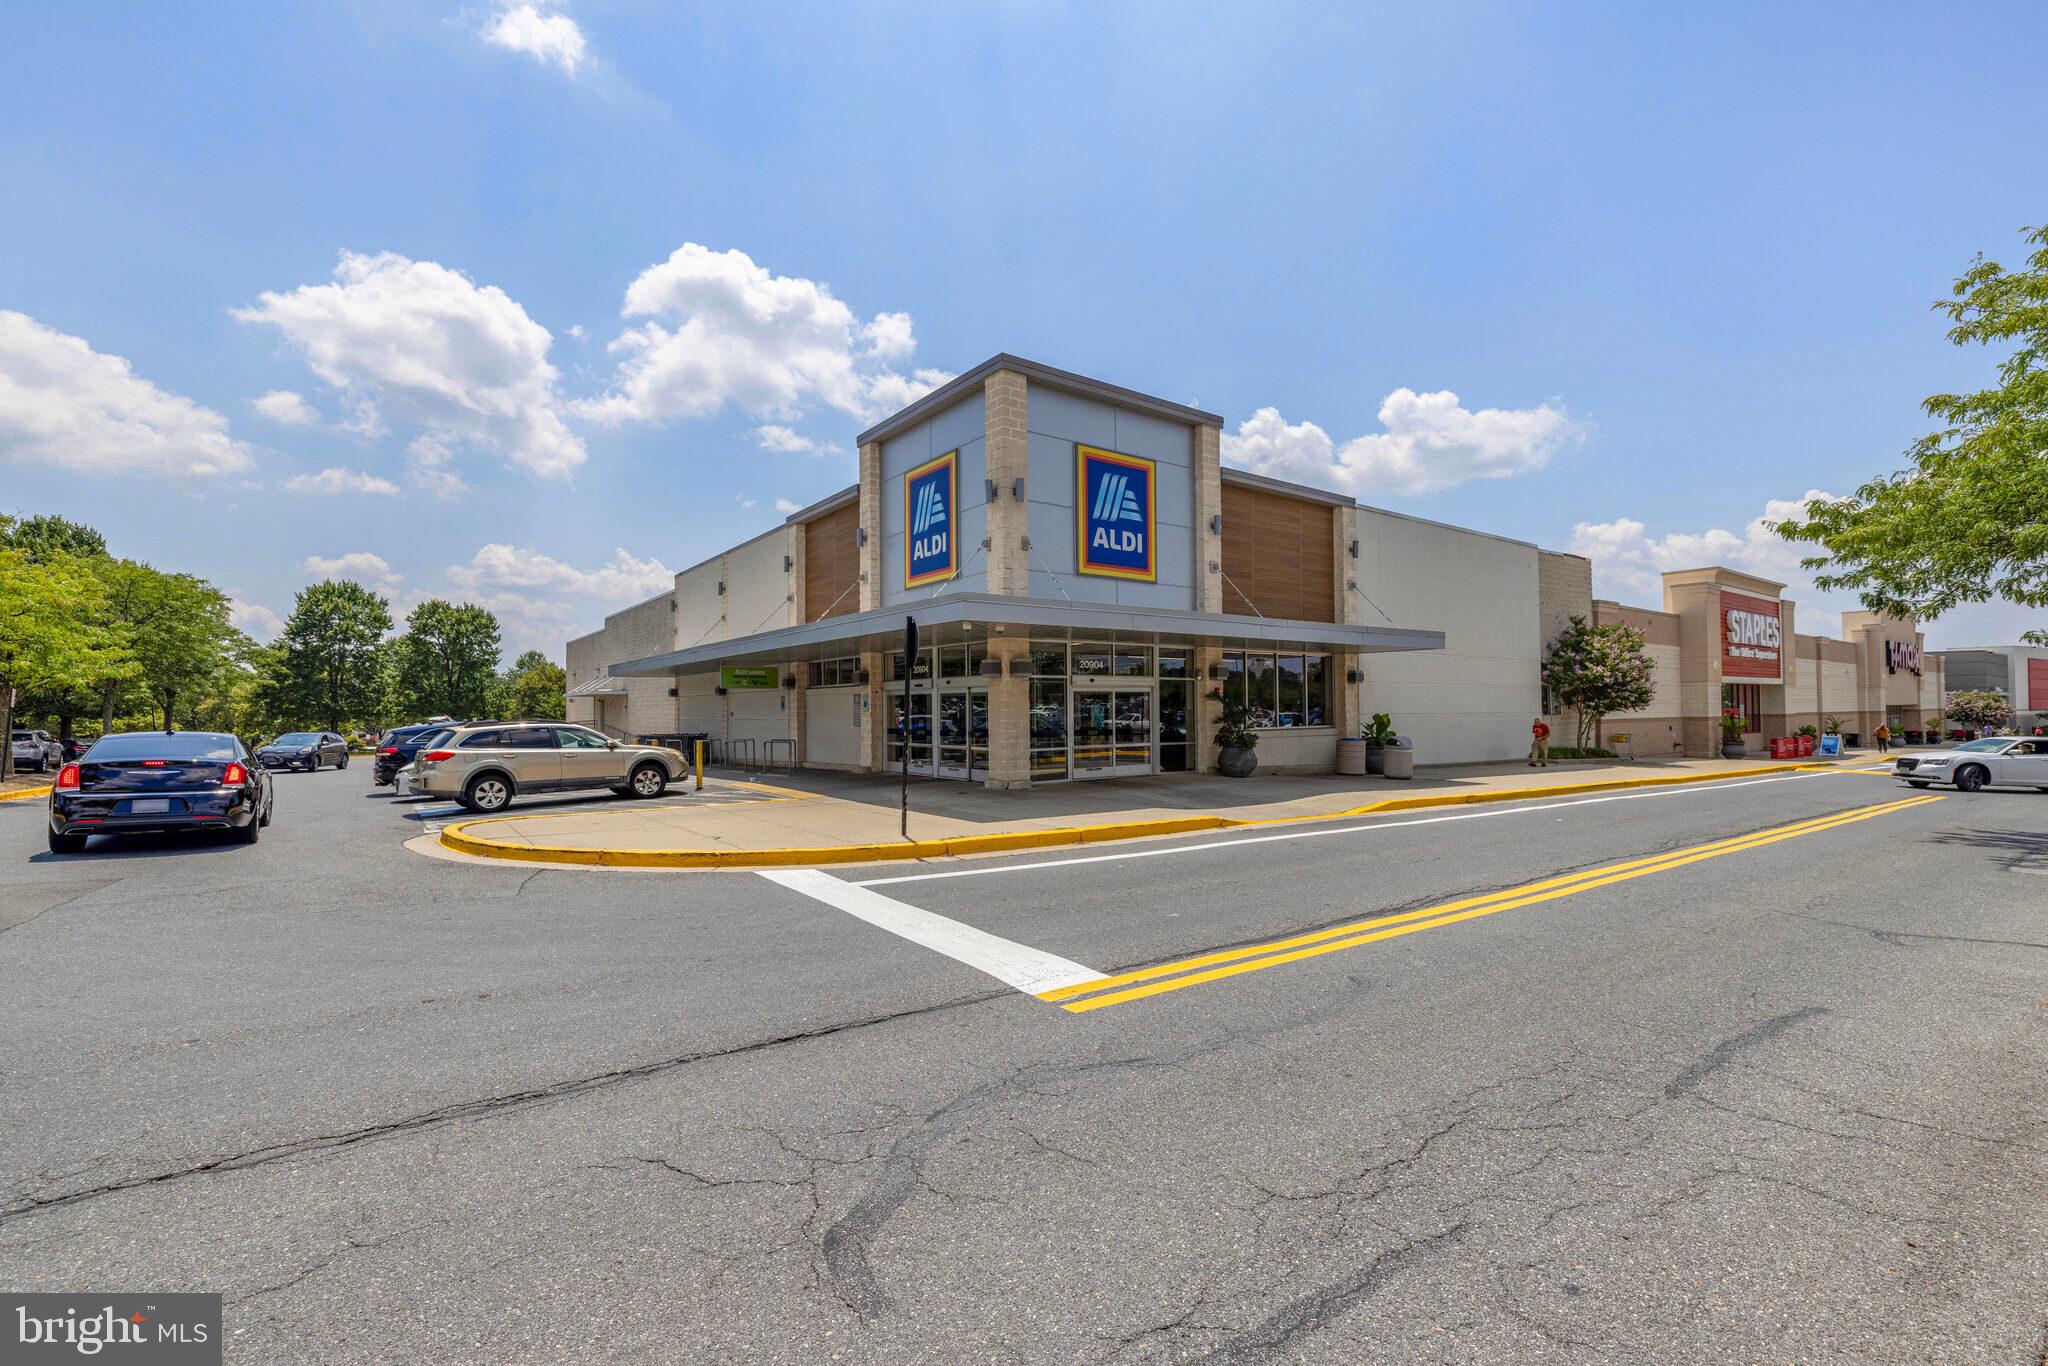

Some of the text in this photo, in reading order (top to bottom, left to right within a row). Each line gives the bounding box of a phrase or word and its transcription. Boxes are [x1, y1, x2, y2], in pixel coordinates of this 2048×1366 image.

[913, 531, 947, 561] ALDI
[1092, 526, 1143, 553] ALDI
[1726, 609, 1780, 648] STAPLES
[913, 665, 929, 674] 20904
[1080, 660, 1104, 669] 20904
